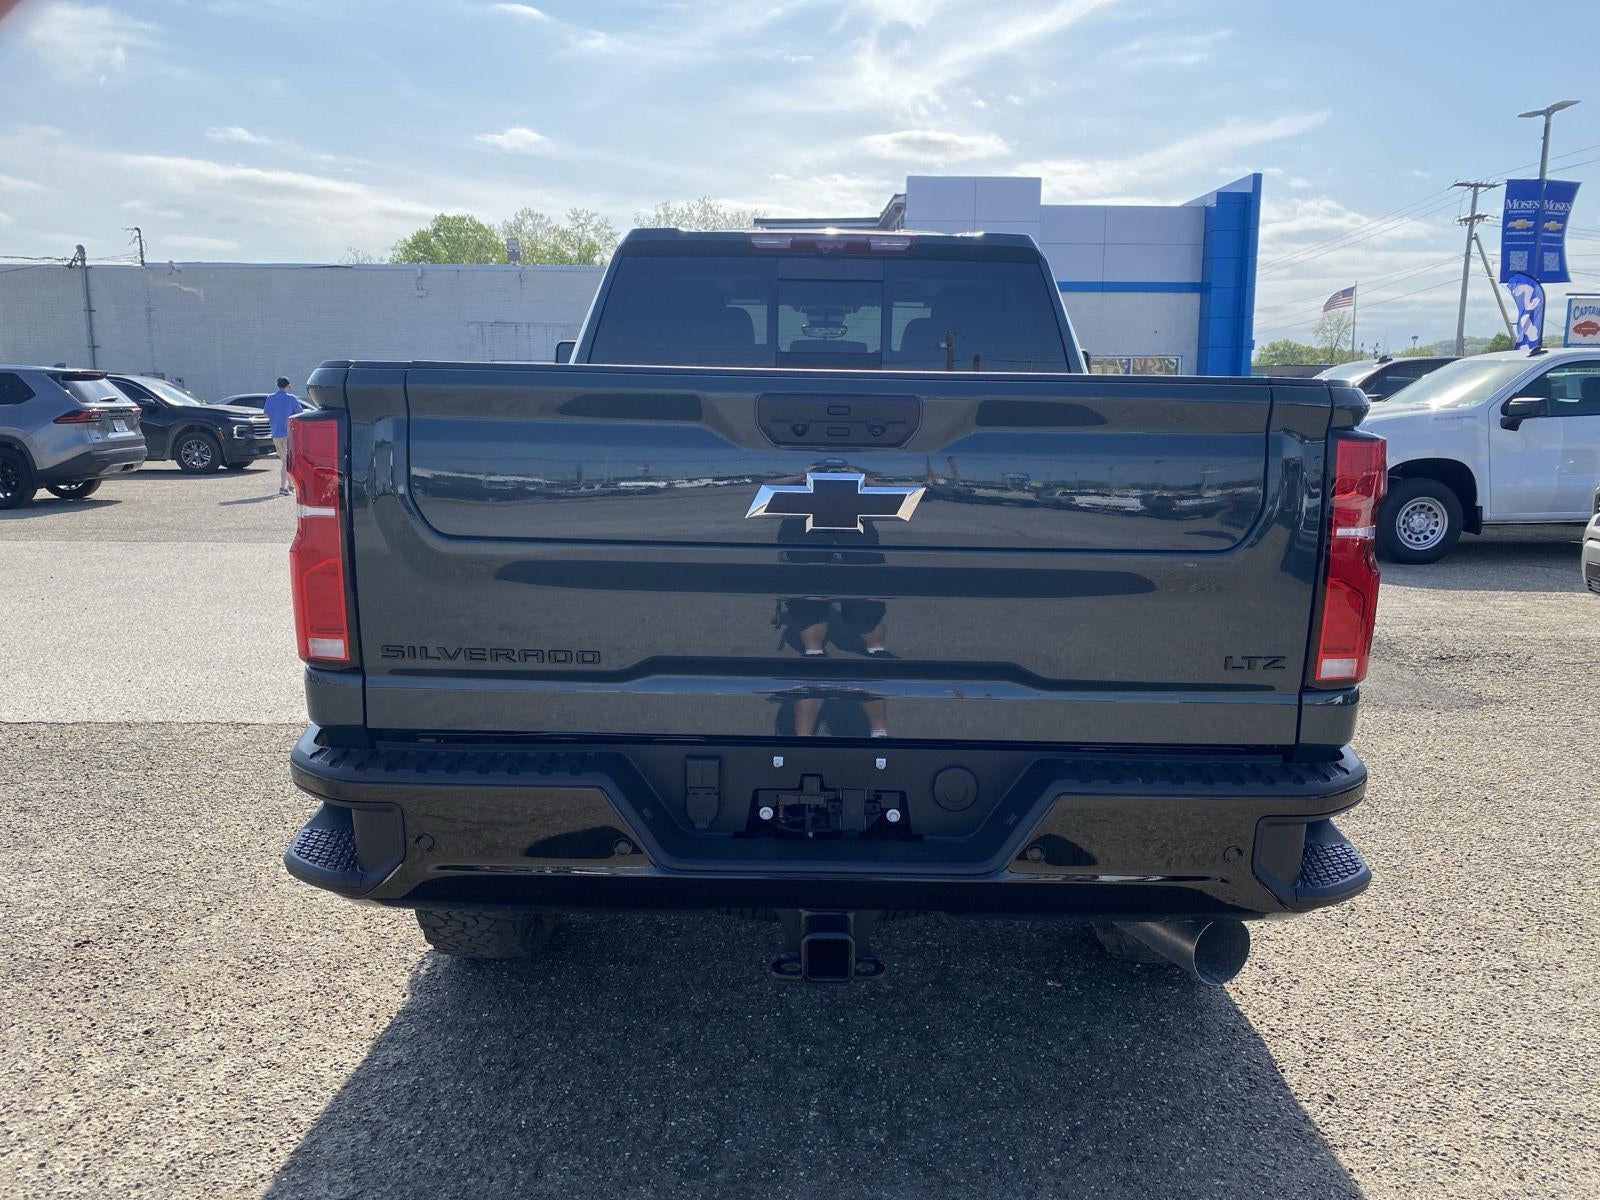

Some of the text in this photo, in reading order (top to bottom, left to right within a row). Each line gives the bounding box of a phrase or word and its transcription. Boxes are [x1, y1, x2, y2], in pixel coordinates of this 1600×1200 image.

[1505, 199, 1540, 210] MOSES
[381, 644, 601, 664] SILVERADO
[1224, 655, 1286, 670] LTZ
